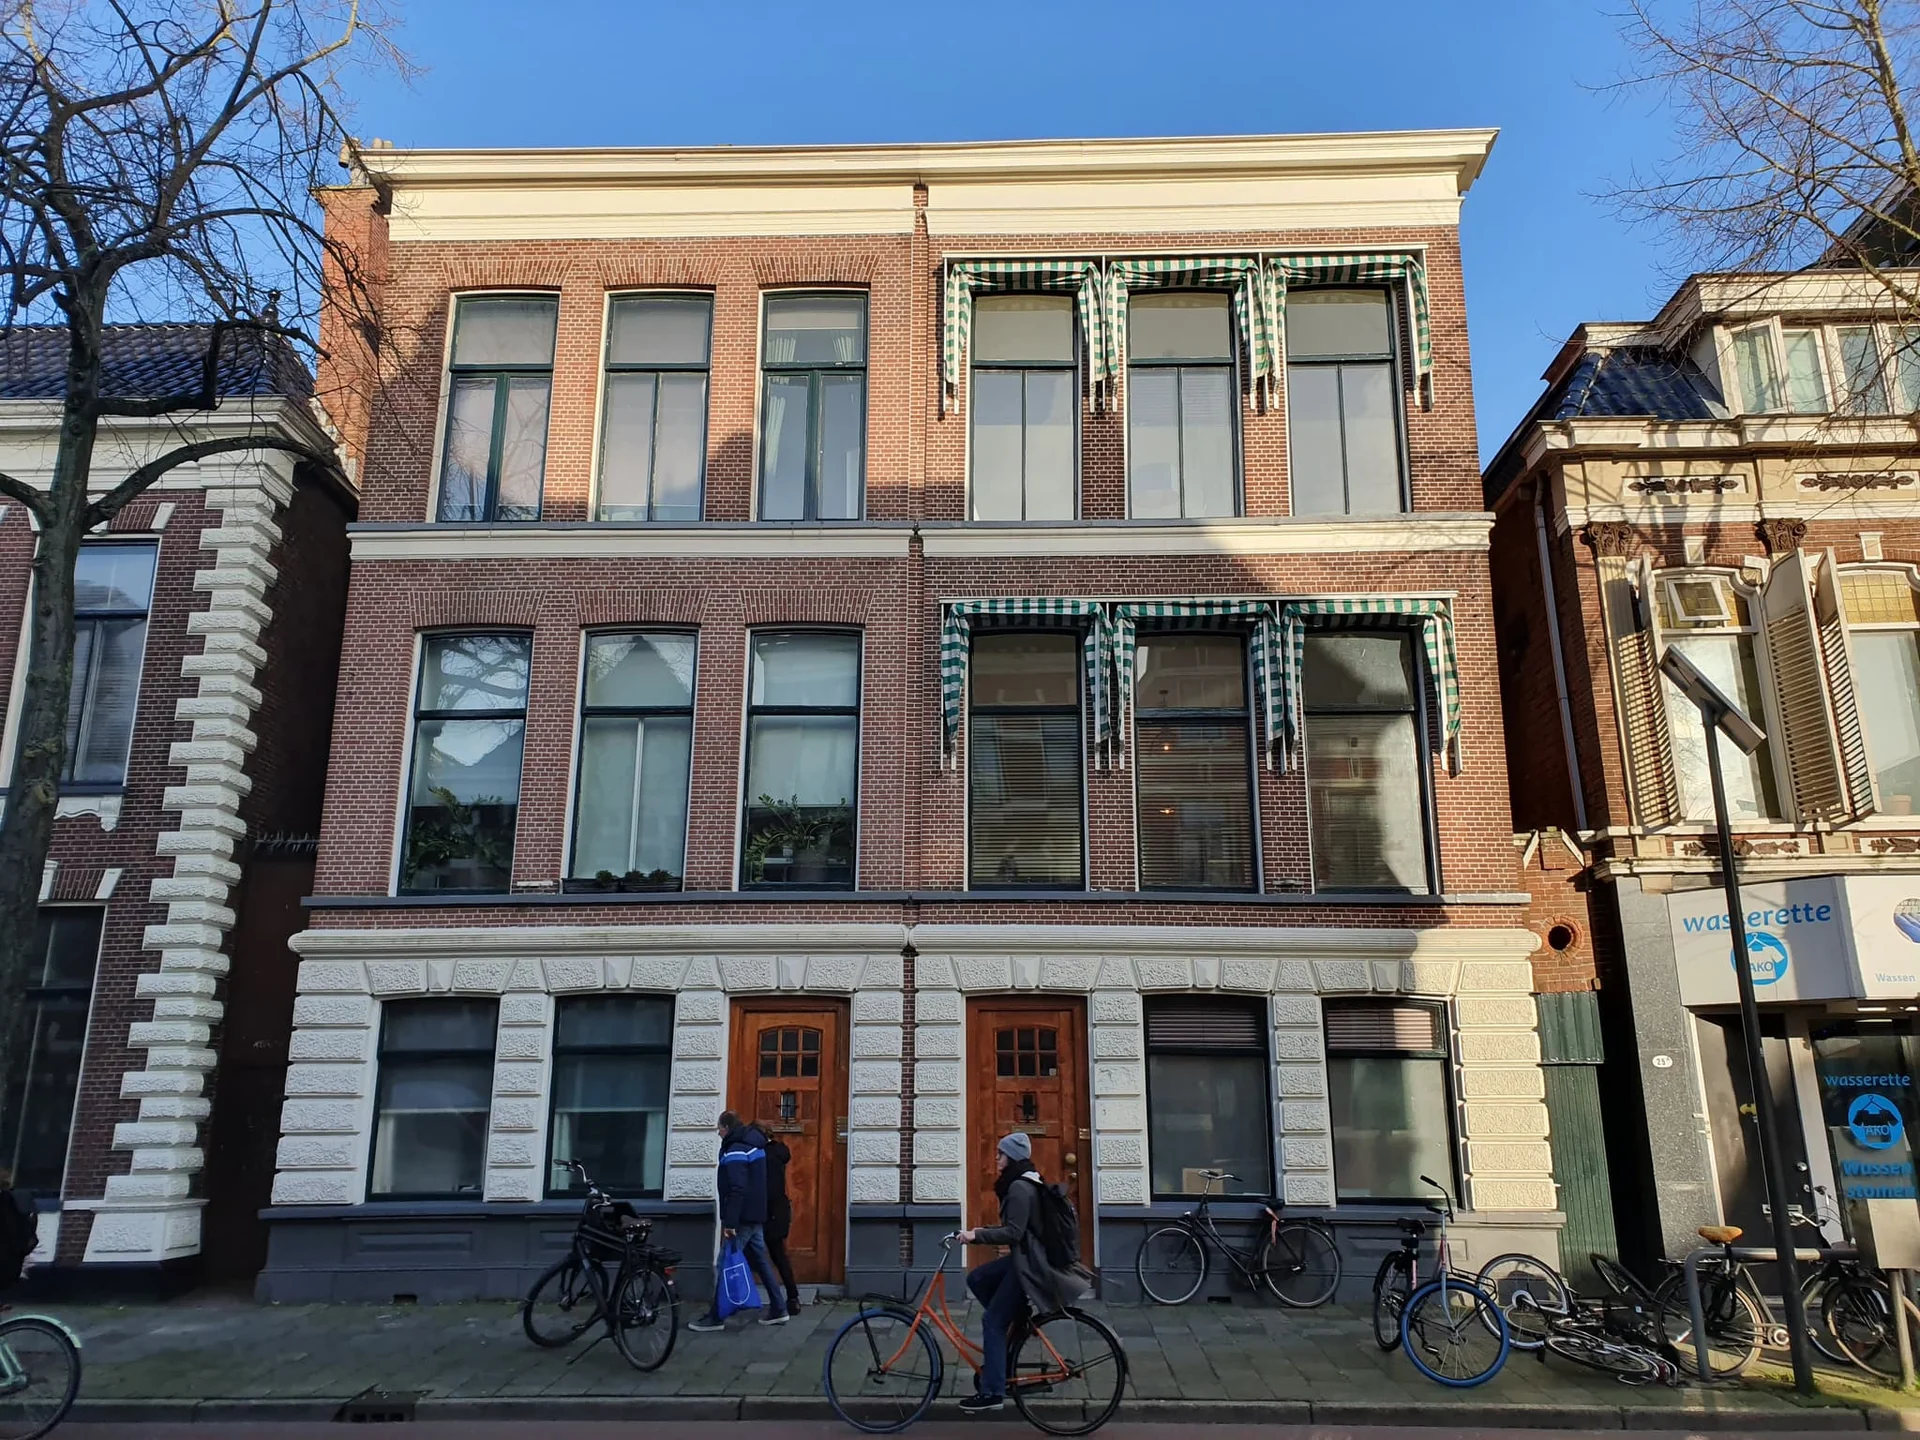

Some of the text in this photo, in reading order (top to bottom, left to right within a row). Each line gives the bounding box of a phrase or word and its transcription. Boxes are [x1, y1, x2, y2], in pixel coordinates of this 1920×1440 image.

[1683, 903, 1831, 932] waserette
[1750, 961, 1774, 973] AKO
[1875, 973, 1916, 982] Wassen
[1824, 1073, 1911, 1087] wasserette
[1866, 1125, 1890, 1136] AKO
